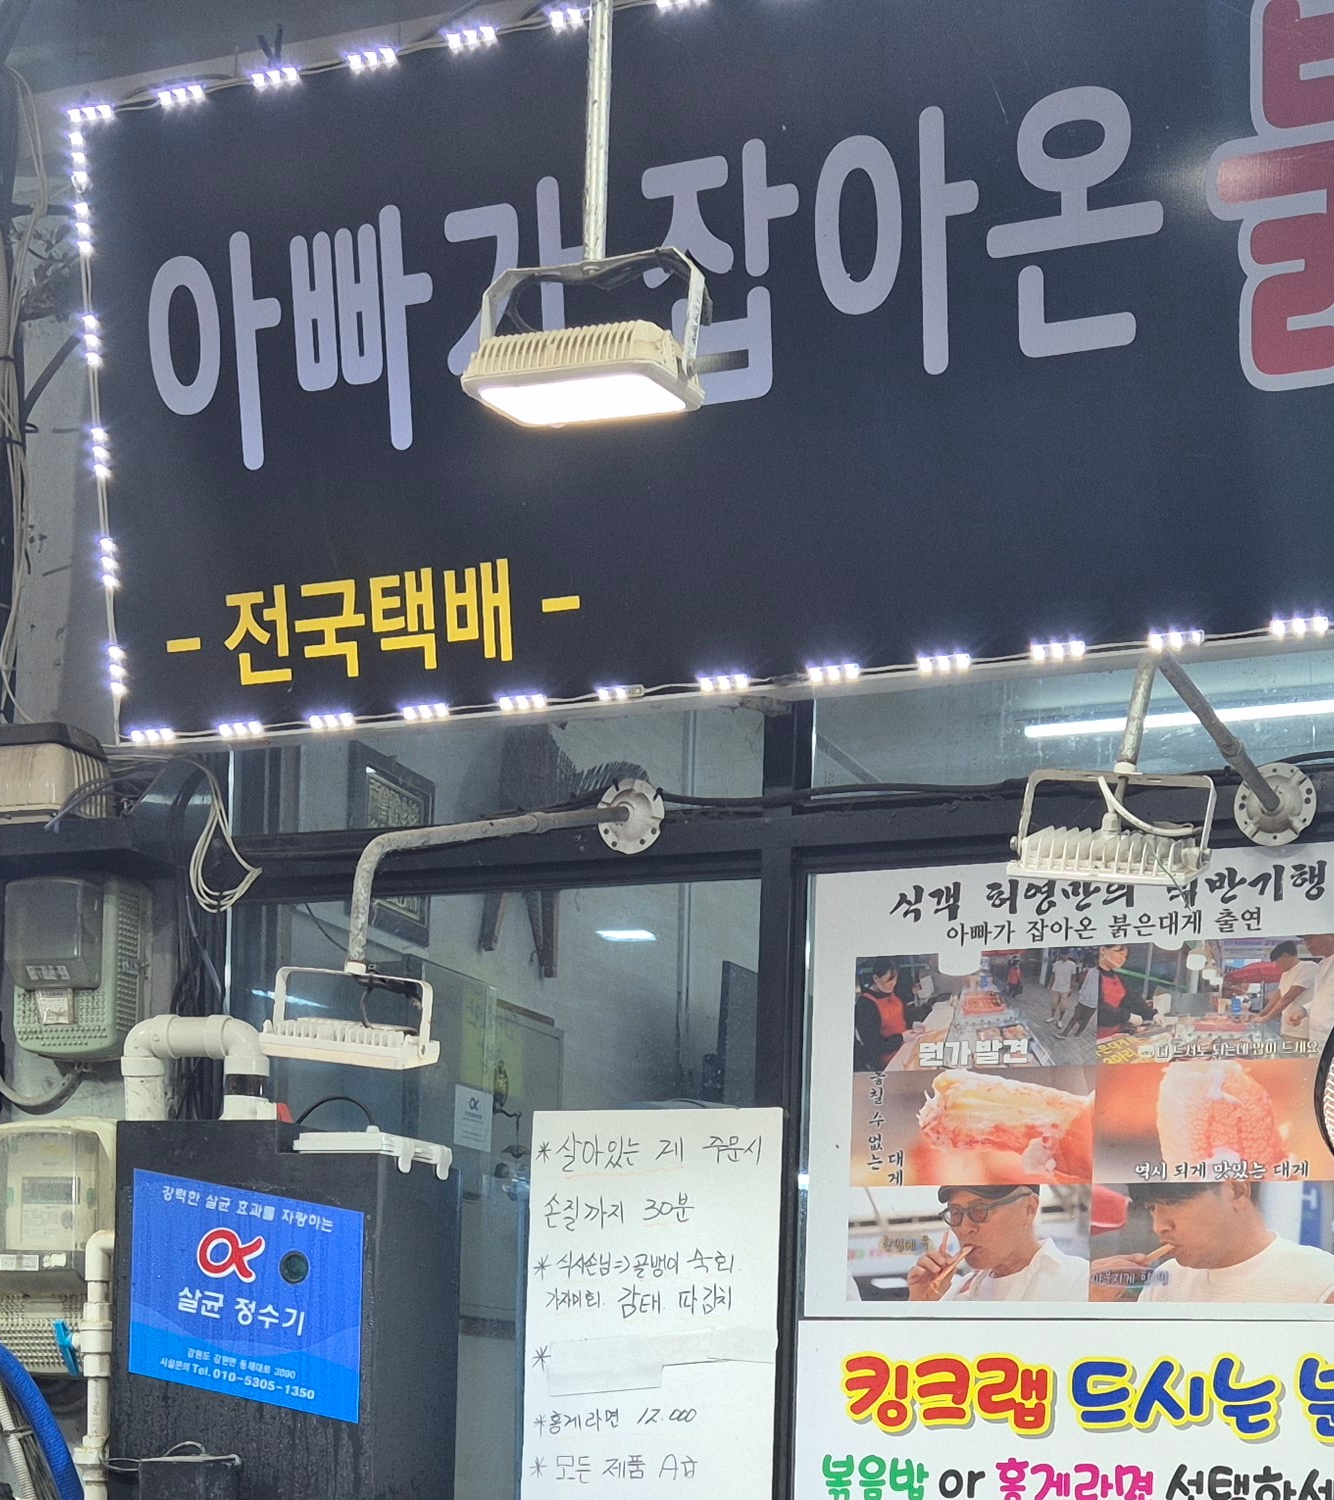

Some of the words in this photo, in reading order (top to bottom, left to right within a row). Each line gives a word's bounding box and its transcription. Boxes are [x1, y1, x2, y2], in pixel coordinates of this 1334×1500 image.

[147, 175, 587, 471] 아빠가
[640, 85, 1164, 405] 잡아온
[224, 559, 513, 687] 전국택배
[889, 881, 961, 922] 식객
[946, 919, 1015, 948] 아빠가
[1026, 915, 1098, 943] 잡아온
[1109, 907, 1203, 938] 붉은대게
[1214, 906, 1263, 934] 출연
[976, 1038, 1029, 1065] 발견
[1281, 1040, 1318, 1055] 드세요
[556, 1132, 641, 1173] 살아있는
[702, 1135, 762, 1165] 주문시
[1134, 1162, 1167, 1180] 역시
[1173, 1161, 1206, 1179] 되게
[1213, 1161, 1266, 1180] 맛있는
[1273, 1160, 1309, 1178] 대게
[161, 1185, 200, 1205] 강력한
[205, 1194, 231, 1212] 살균
[281, 1209, 333, 1233] 자랑하는
[544, 1192, 624, 1232] 손질까지
[643, 1192, 695, 1223] 30분
[178, 1286, 224, 1319] 살균
[234, 1297, 305, 1337] 정수기
[213, 1369, 315, 1400] 010-5305-1350
[841, 1352, 1057, 1437] 킹크랩
[1068, 1354, 1284, 1442] 드시는
[549, 1408, 619, 1435] 홍게라면
[556, 1455, 592, 1484] 모든
[602, 1454, 646, 1479] 제품
[939, 1467, 986, 1500] or
